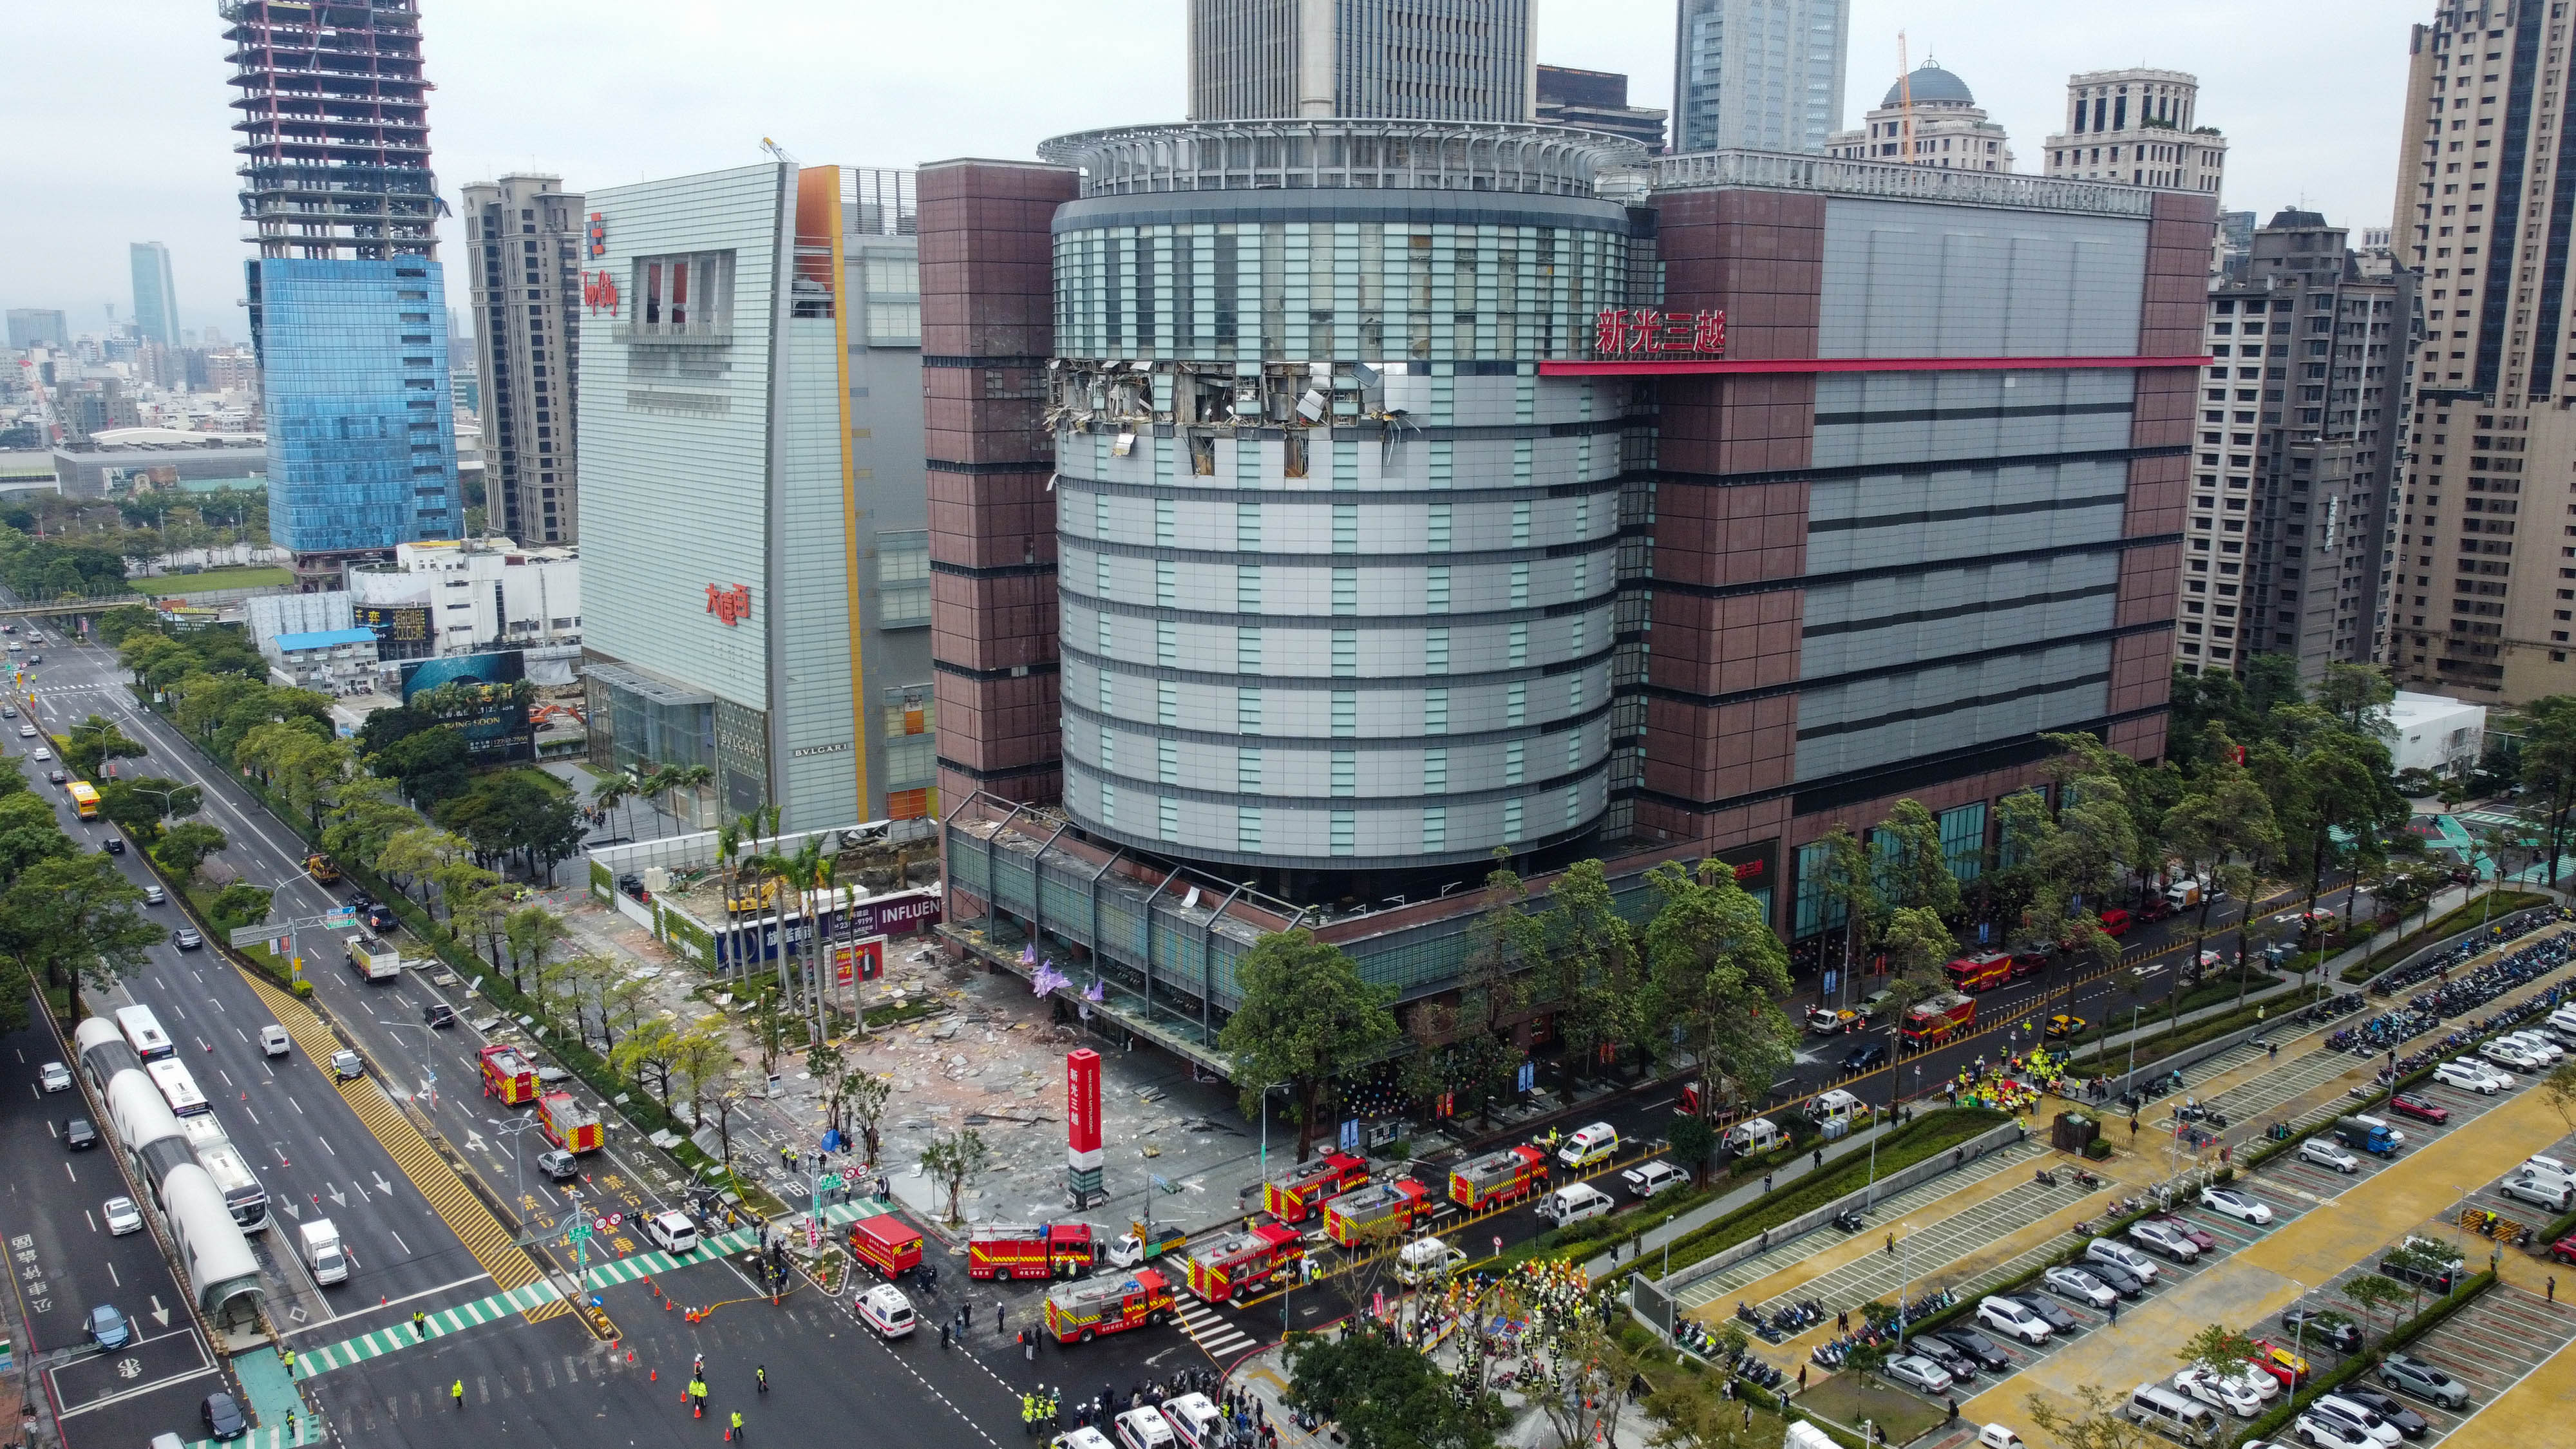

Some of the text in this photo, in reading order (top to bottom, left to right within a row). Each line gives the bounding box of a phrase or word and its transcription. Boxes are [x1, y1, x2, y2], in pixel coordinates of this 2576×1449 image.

[1595, 308, 1727, 354] 新光三越
[721, 734, 761, 757] BVLGARI
[795, 743, 848, 757] BVLGARI
[1070, 1068, 1079, 1127] 新光三越
